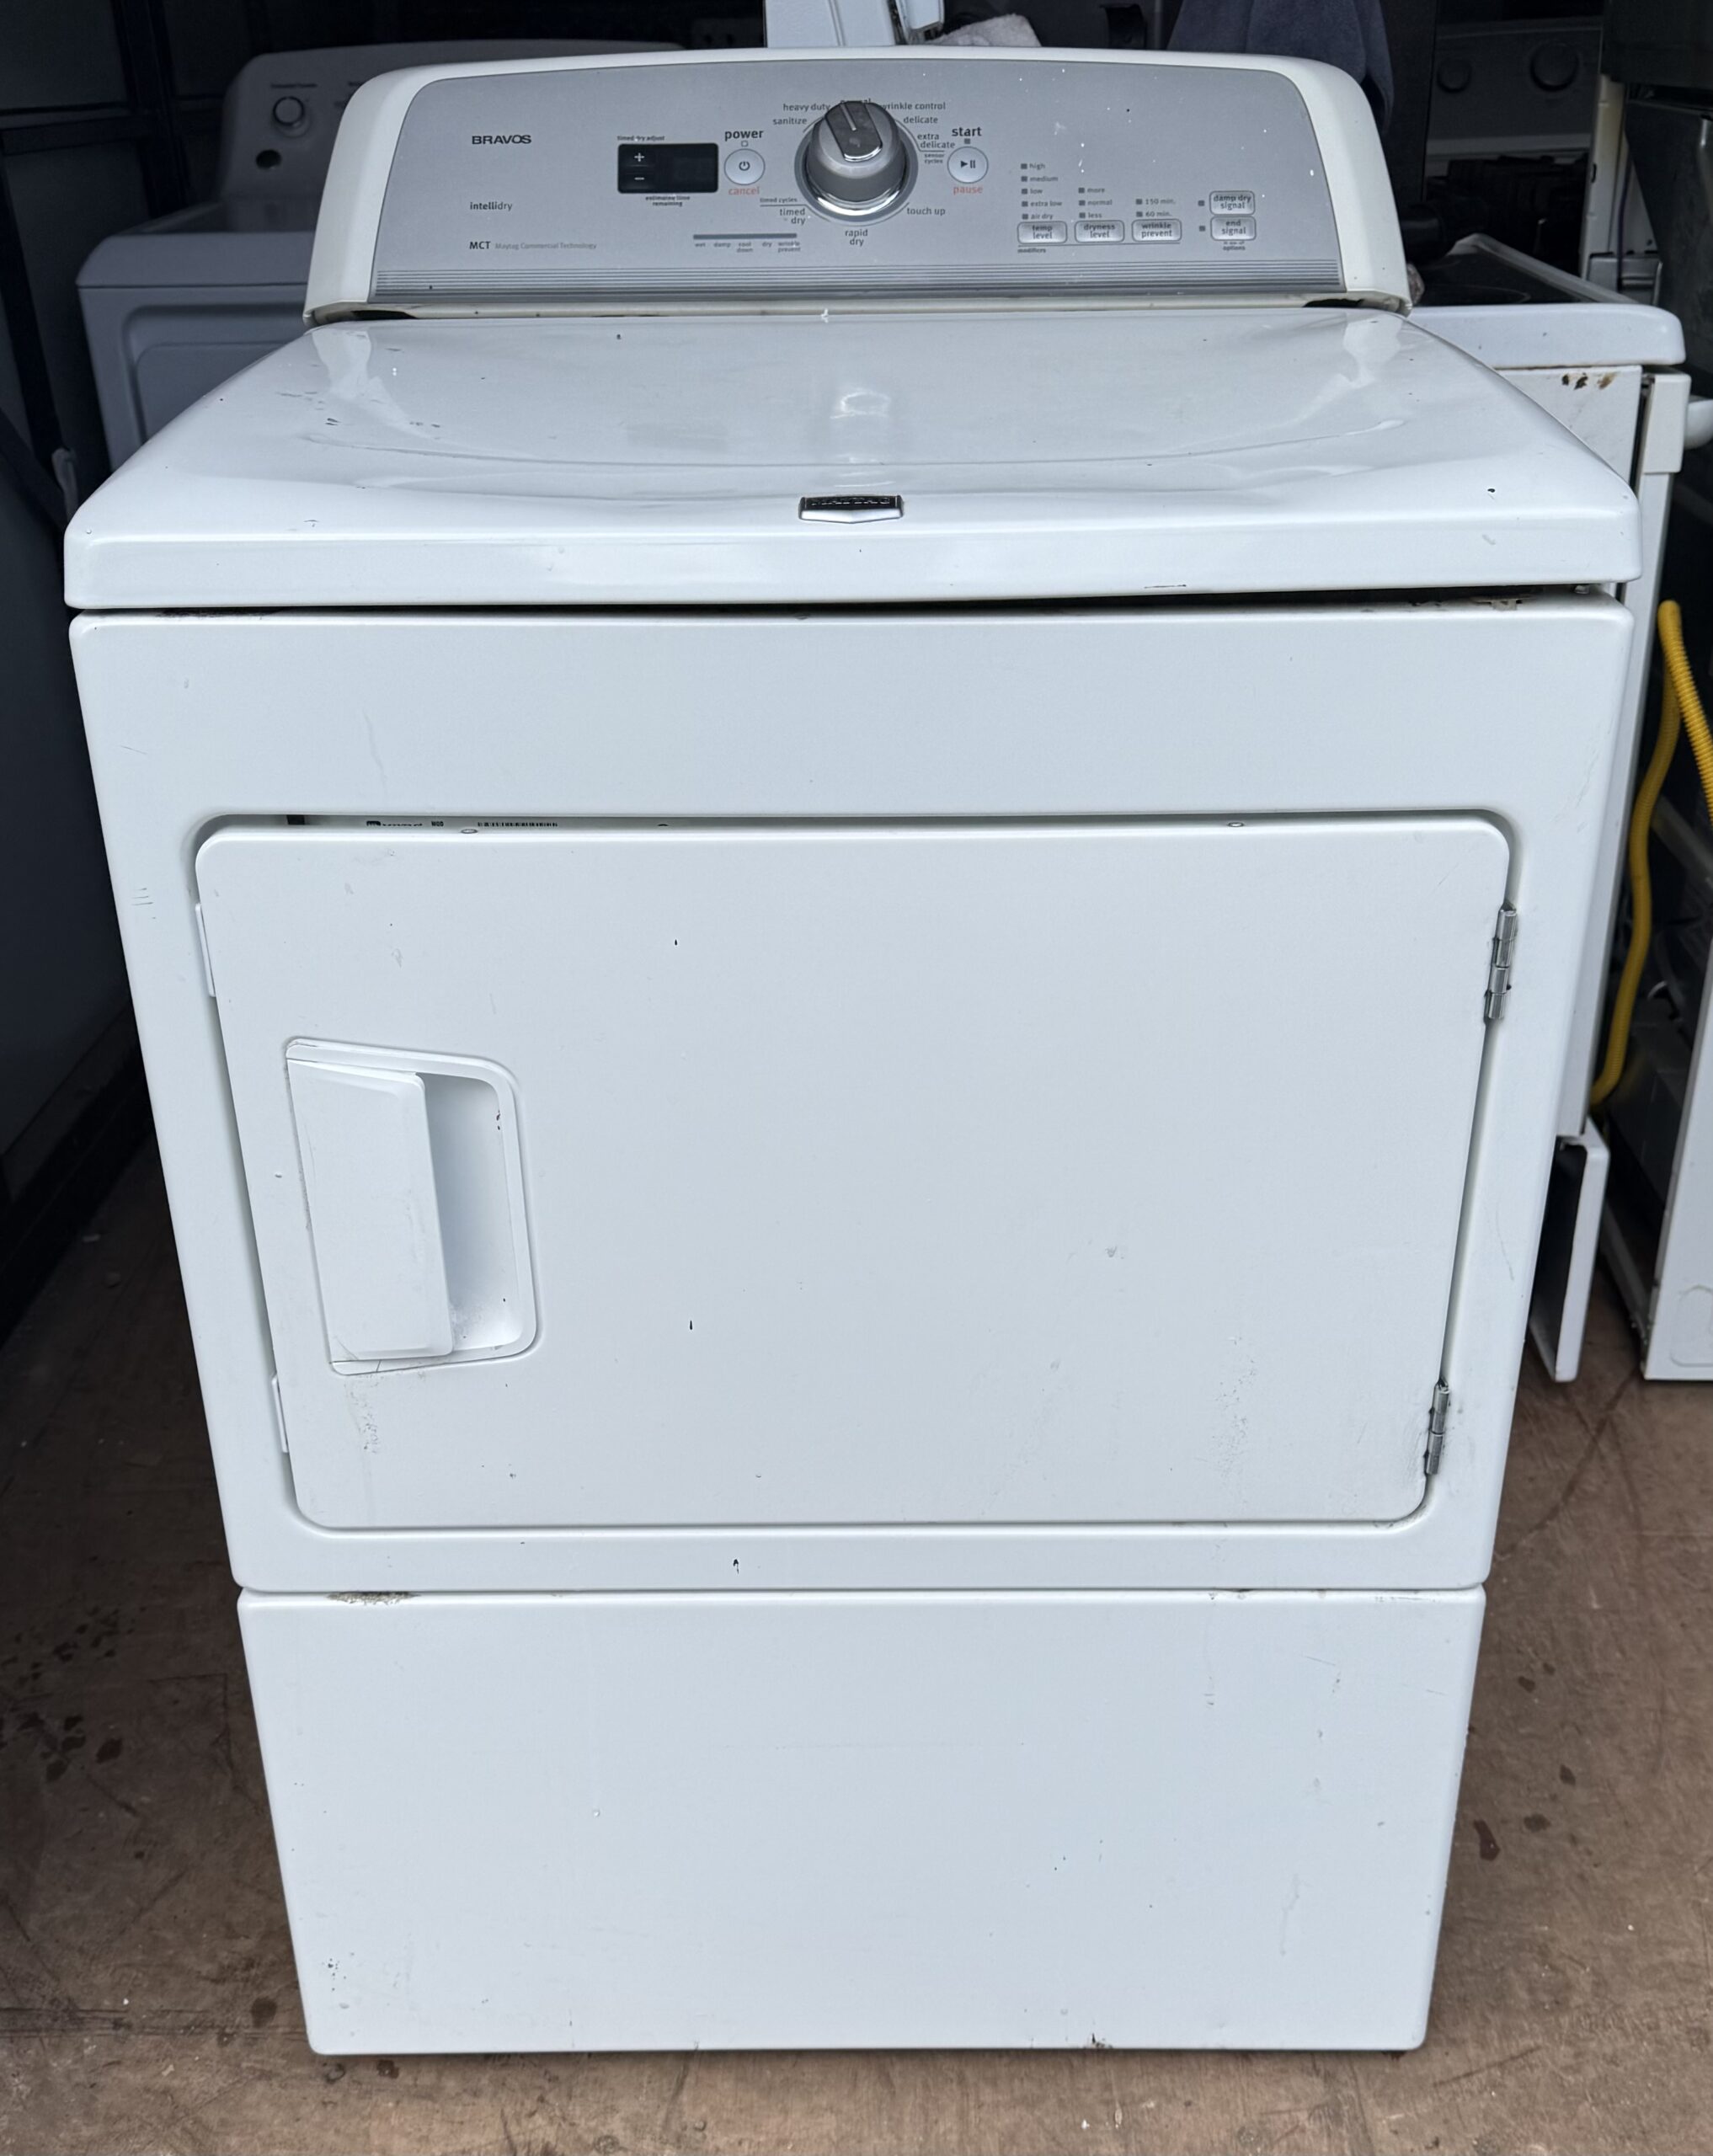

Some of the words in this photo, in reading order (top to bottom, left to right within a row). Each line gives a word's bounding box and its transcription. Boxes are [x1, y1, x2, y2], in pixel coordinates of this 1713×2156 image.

[783, 103, 809, 112] heavy
[810, 104, 831, 112] duty
[772, 117, 808, 125] sanitize
[724, 130, 764, 141] power
[952, 127, 982, 137] start
[472, 135, 531, 144] BRAVOS
[728, 187, 760, 195] cancel
[953, 186, 983, 195] pause
[1214, 194, 1235, 203] damp
[1237, 194, 1251, 203] dry
[470, 202, 512, 211] intellidry
[907, 206, 930, 216] touch
[780, 207, 805, 216] timed
[792, 216, 806, 225] dry
[1083, 223, 1115, 232] dryness
[1221, 227, 1246, 236] signal
[845, 229, 868, 237] rapid
[1033, 231, 1053, 239] level
[1141, 229, 1172, 237] prevent
[559, 242, 597, 250] Technology
[849, 237, 864, 247] dry
